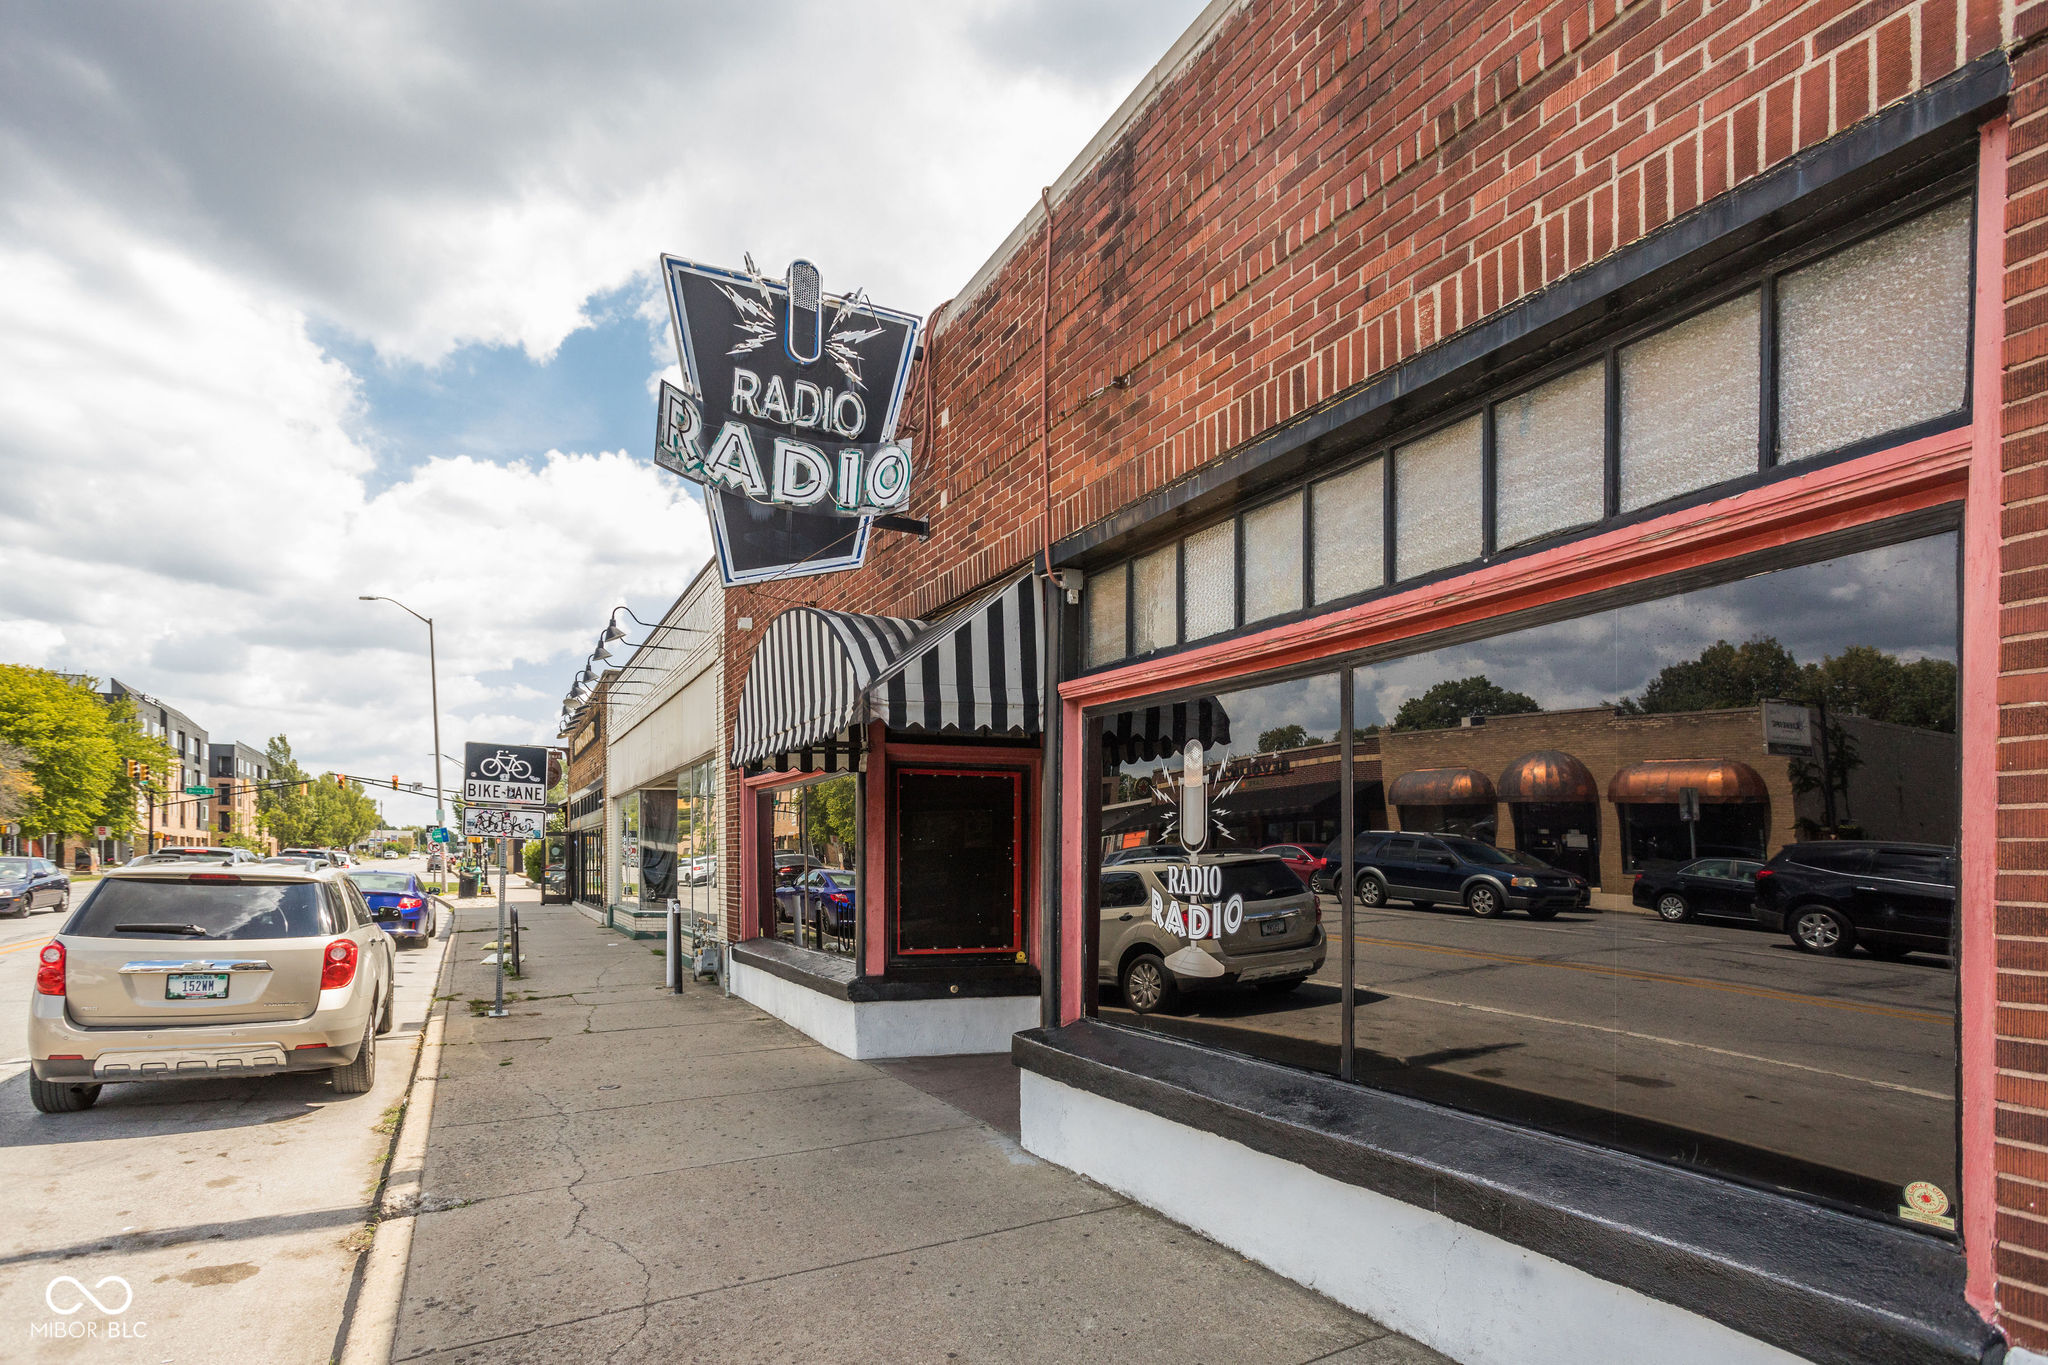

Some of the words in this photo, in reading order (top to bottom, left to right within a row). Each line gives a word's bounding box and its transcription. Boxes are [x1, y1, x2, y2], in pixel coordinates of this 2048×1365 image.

[732, 367, 867, 440] RADIO
[660, 388, 912, 512] RADIO
[468, 783, 501, 798] BIKE
[1167, 865, 1222, 897] RADIO
[1151, 887, 1244, 940] RADIO
[182, 980, 215, 992] 152WM
